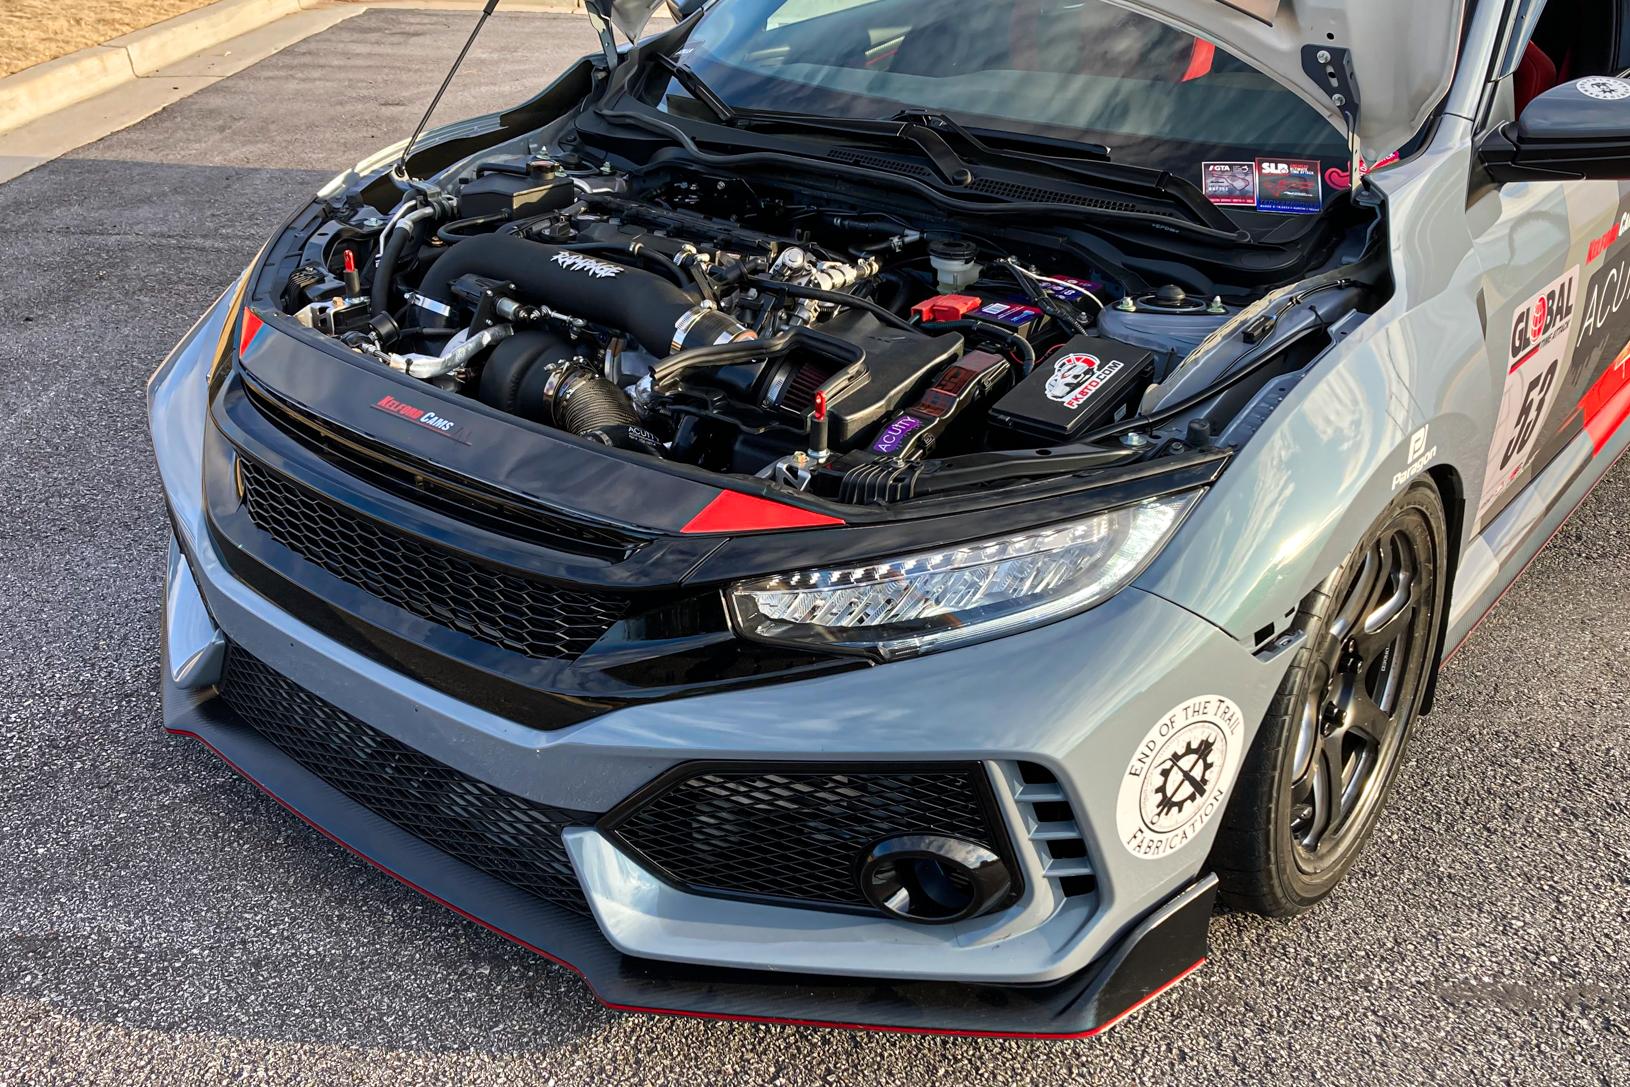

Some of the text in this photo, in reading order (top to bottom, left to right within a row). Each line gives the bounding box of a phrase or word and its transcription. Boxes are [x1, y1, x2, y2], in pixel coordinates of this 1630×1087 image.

[1511, 276, 1574, 358] GLOBAL
[1577, 261, 1630, 347] ACU
[420, 411, 454, 431] CAMS
[879, 415, 916, 452] ACUITY
[1500, 359, 1558, 471] 53
[1391, 445, 1437, 491] Paragon
[1128, 739, 1157, 778] END
[1159, 714, 1177, 737] OF
[1182, 700, 1212, 721] THE
[1127, 788, 1225, 856] FABRICATION
